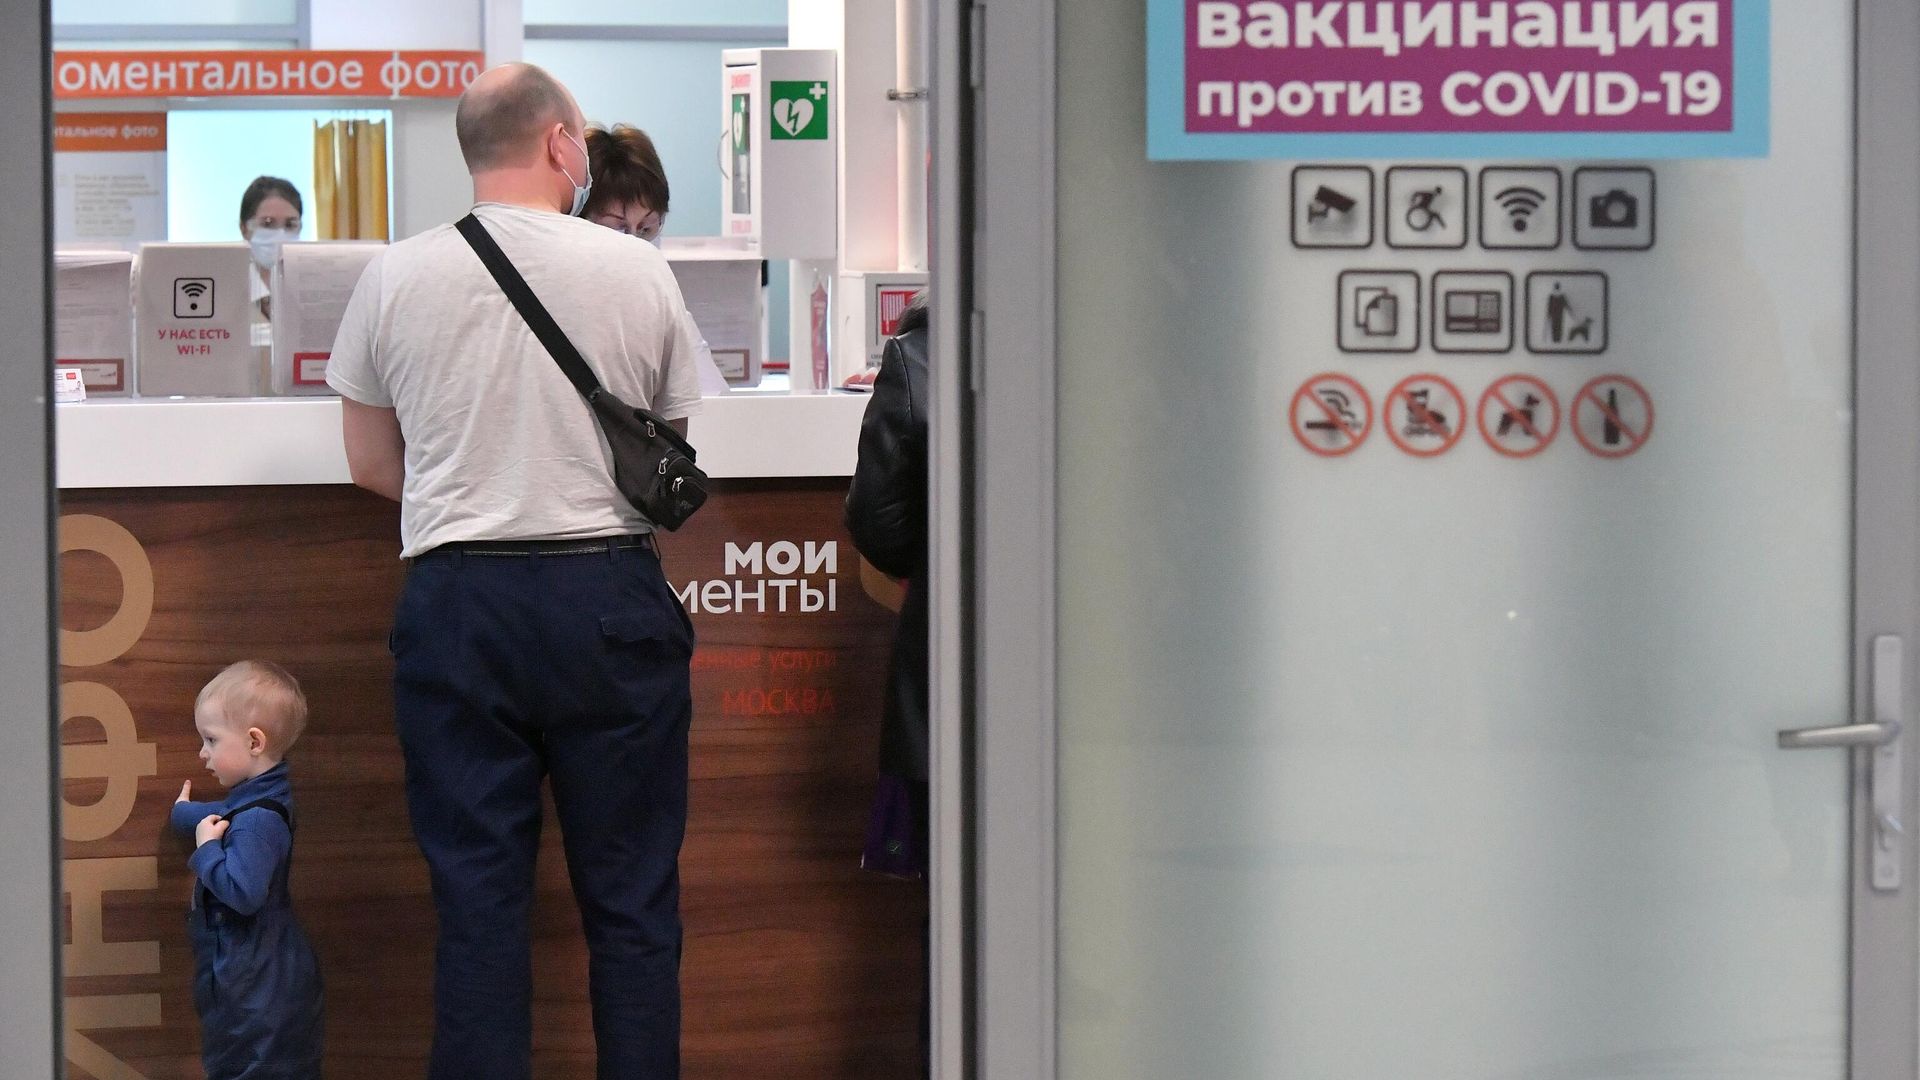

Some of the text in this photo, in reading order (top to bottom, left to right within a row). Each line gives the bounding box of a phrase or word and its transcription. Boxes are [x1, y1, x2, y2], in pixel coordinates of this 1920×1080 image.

[1198, 1, 1719, 56] вакцинация
[58, 50, 480, 99] оментальное фото
[1198, 70, 1722, 127] против COVID-19
[158, 329, 231, 340] У НАС ЕСТЬ
[177, 344, 211, 355] WI-FI
[722, 687, 836, 717] МОСКВА
